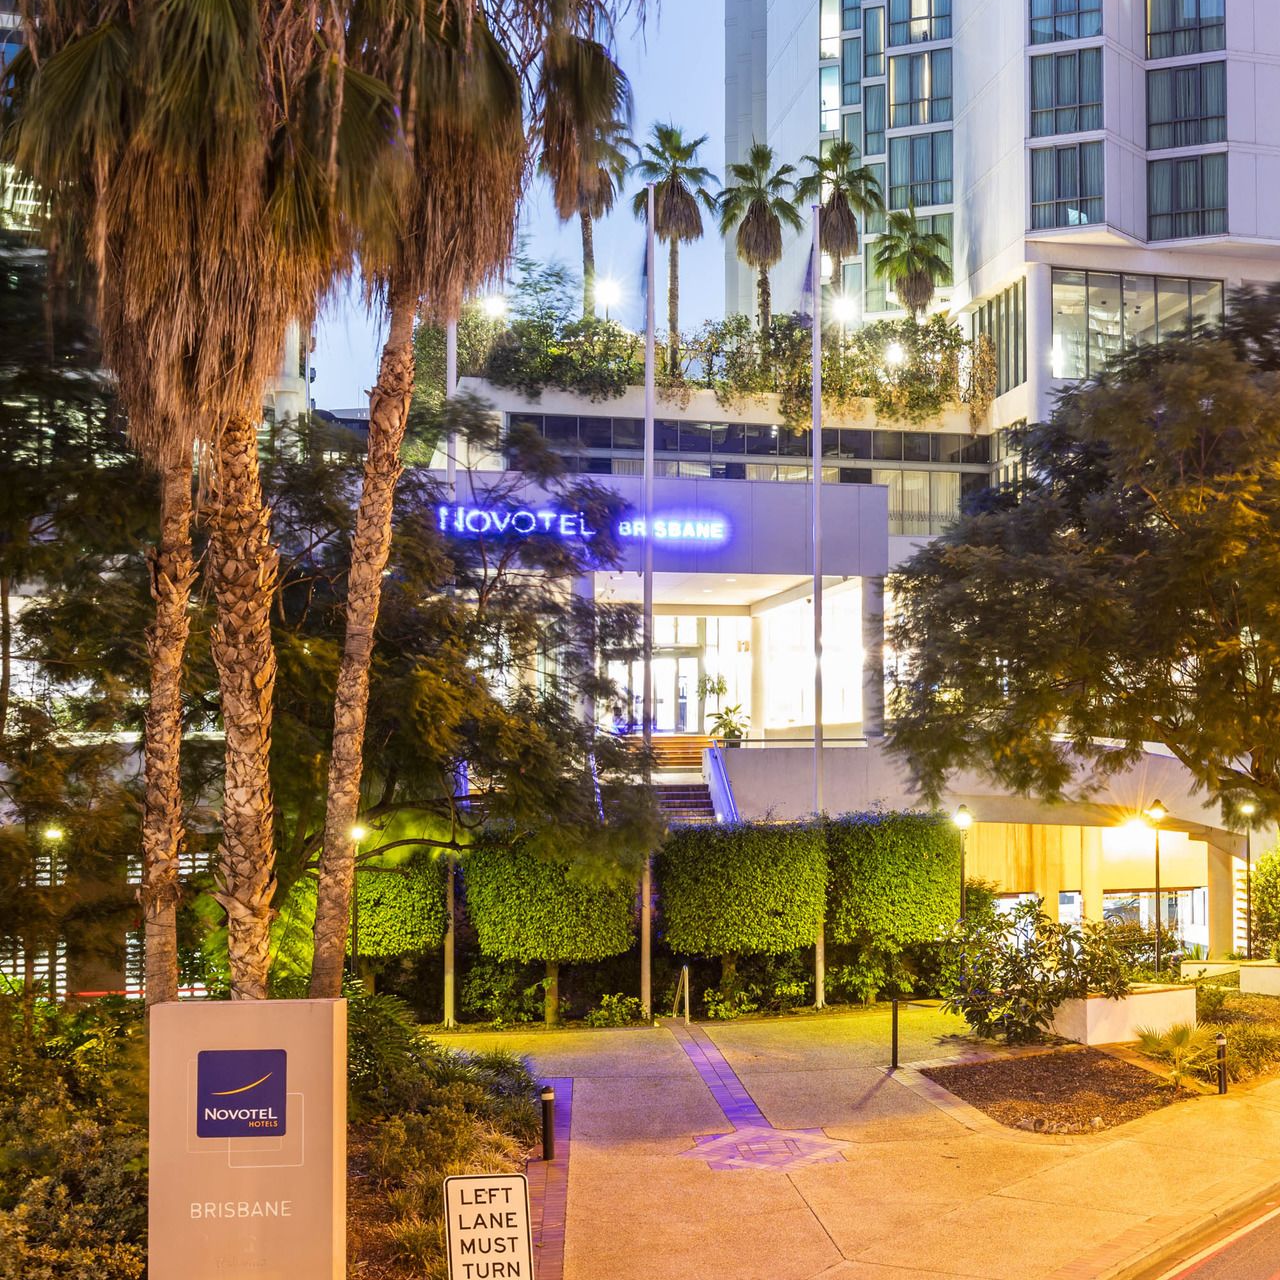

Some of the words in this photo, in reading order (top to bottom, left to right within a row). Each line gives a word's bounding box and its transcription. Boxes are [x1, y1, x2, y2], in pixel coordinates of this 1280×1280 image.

[439, 506, 596, 536] NOVOTEL
[618, 520, 724, 539] BRSBANE
[204, 1107, 278, 1121] NOVOTEL
[248, 1120, 278, 1128] HOTELS
[460, 1187, 513, 1205] LEFT
[190, 1200, 293, 1219] BRISBANE
[458, 1212, 518, 1230] LANE
[460, 1236, 519, 1255] MUST
[462, 1261, 521, 1280] TURN
